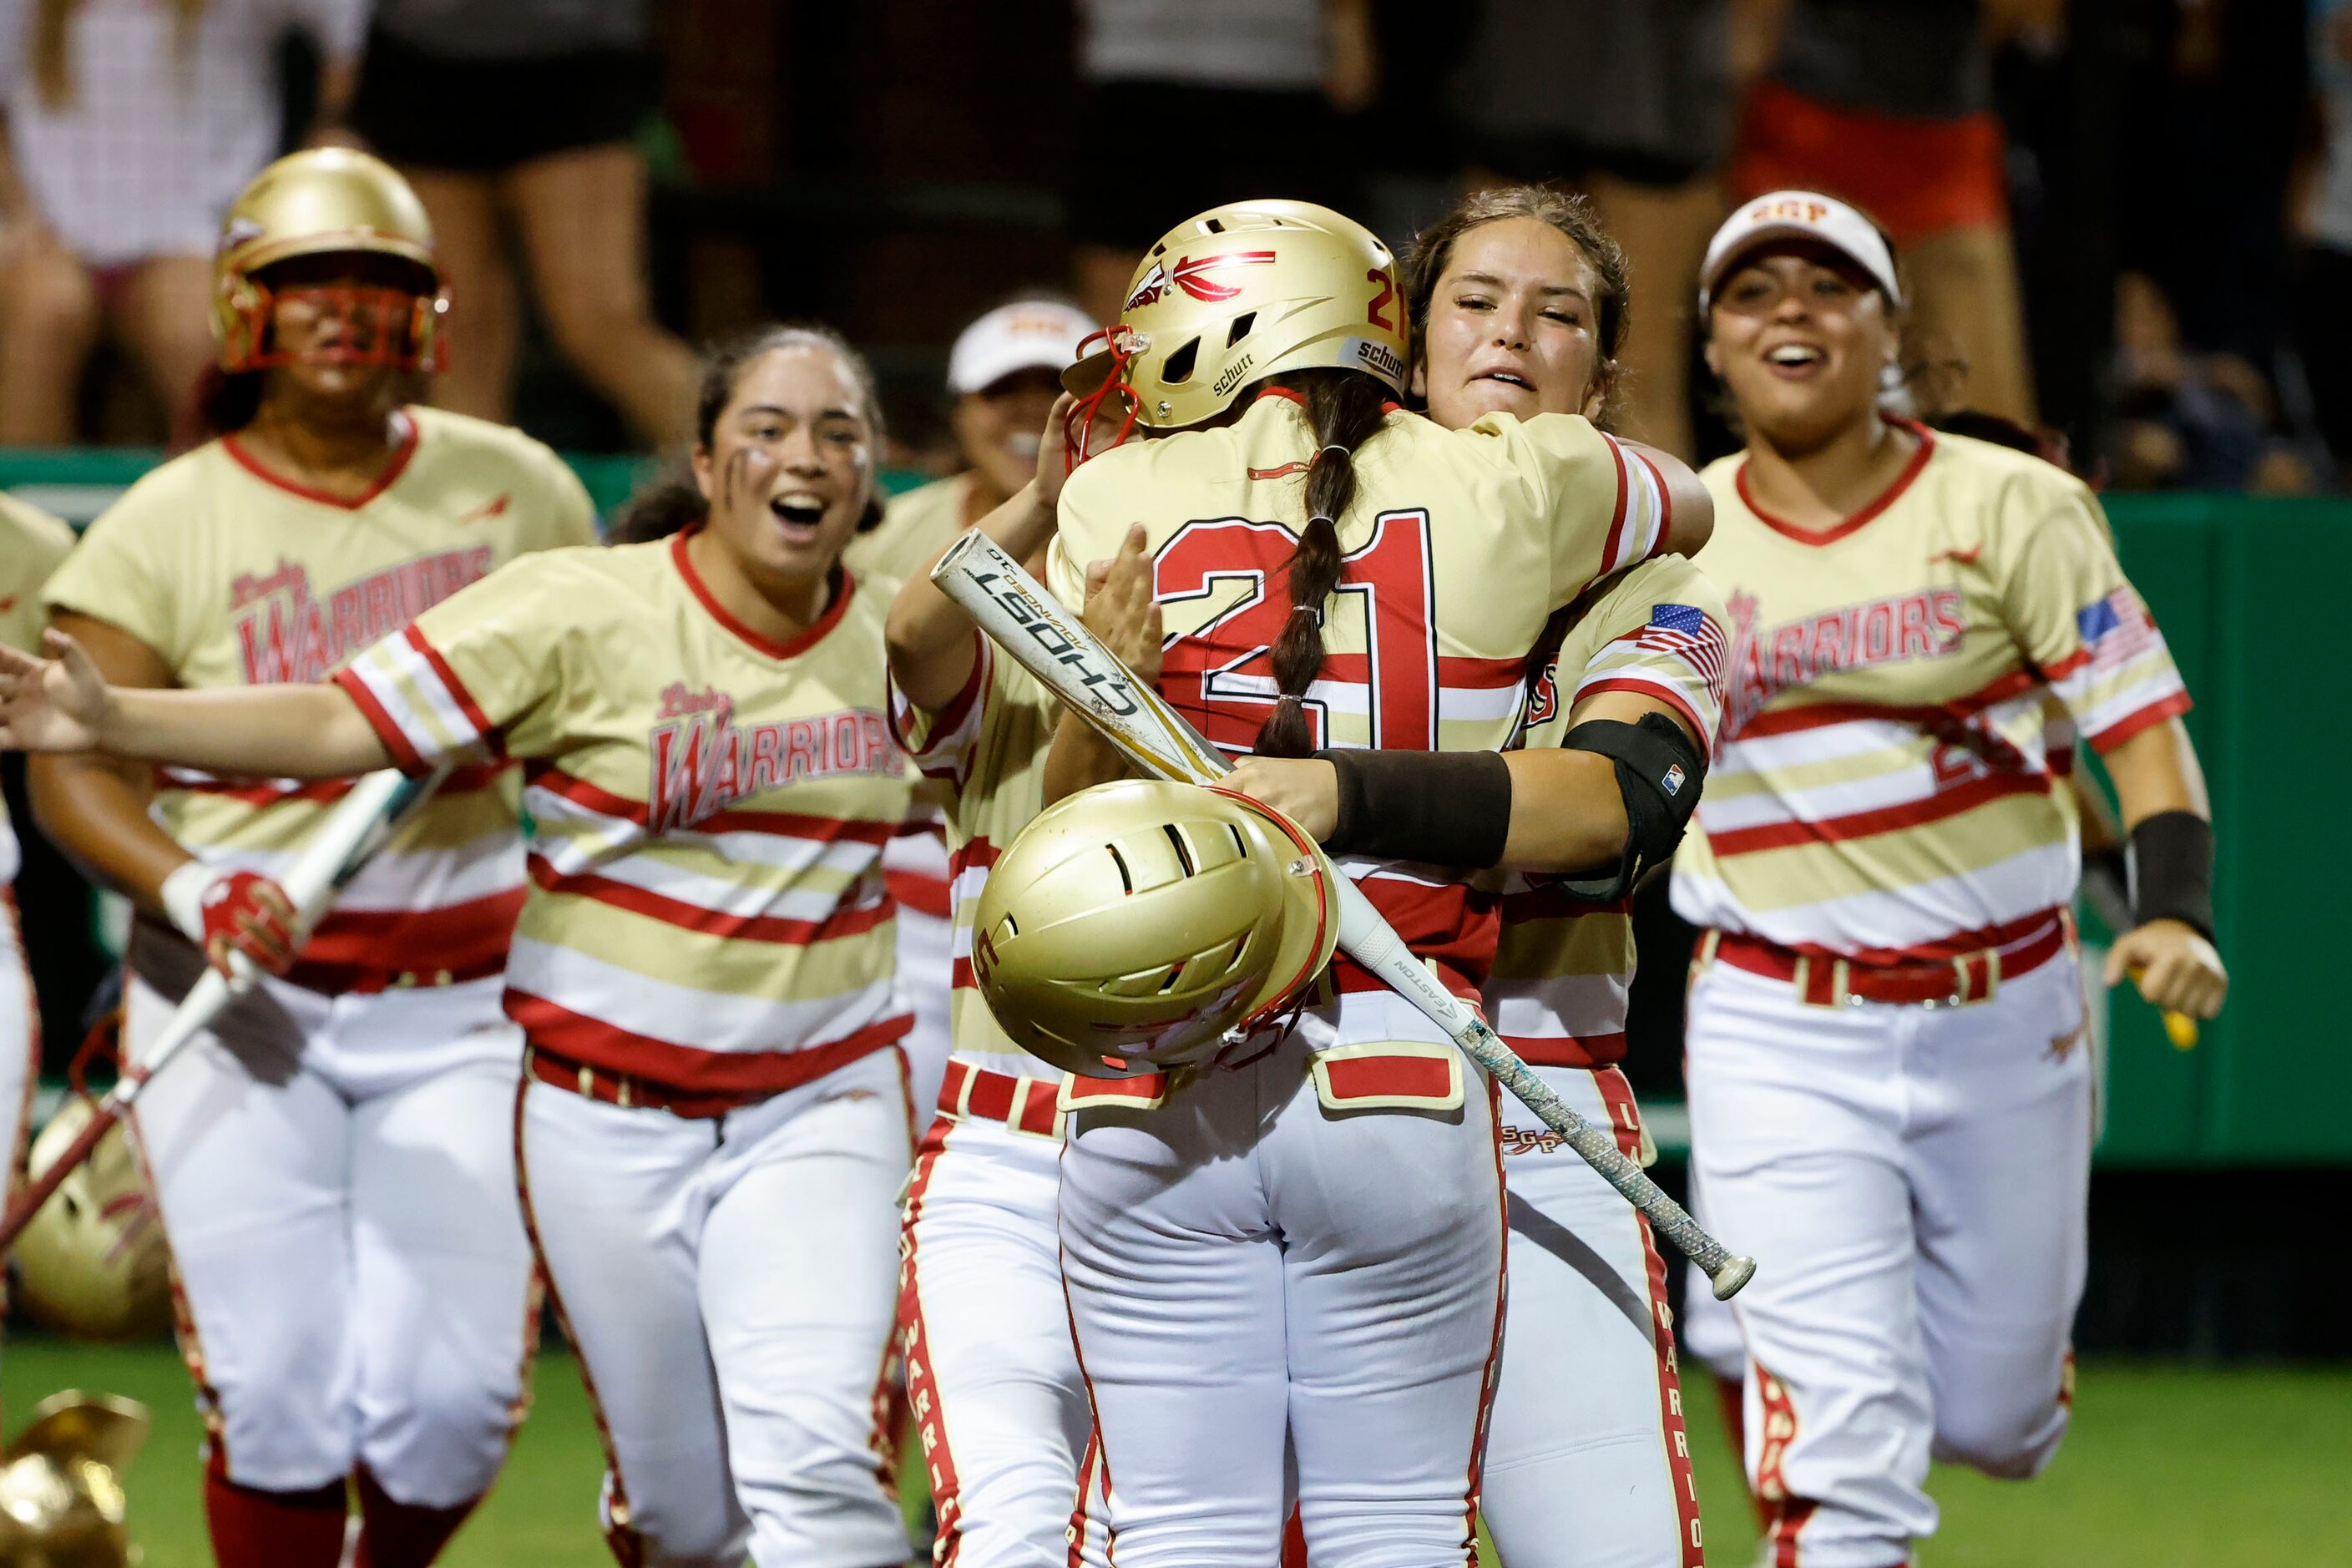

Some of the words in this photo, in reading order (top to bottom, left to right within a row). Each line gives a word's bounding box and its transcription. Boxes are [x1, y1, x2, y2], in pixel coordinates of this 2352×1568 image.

[1367, 268, 1404, 341] 21
[1213, 354, 1254, 397] schutt
[962, 568, 1138, 716] GHOST
[1003, 574, 1089, 651] ADVANCED
[1153, 507, 1439, 751] 21
[1393, 960, 1446, 1008] EASTON
[1502, 1125, 1556, 1154] SGP
